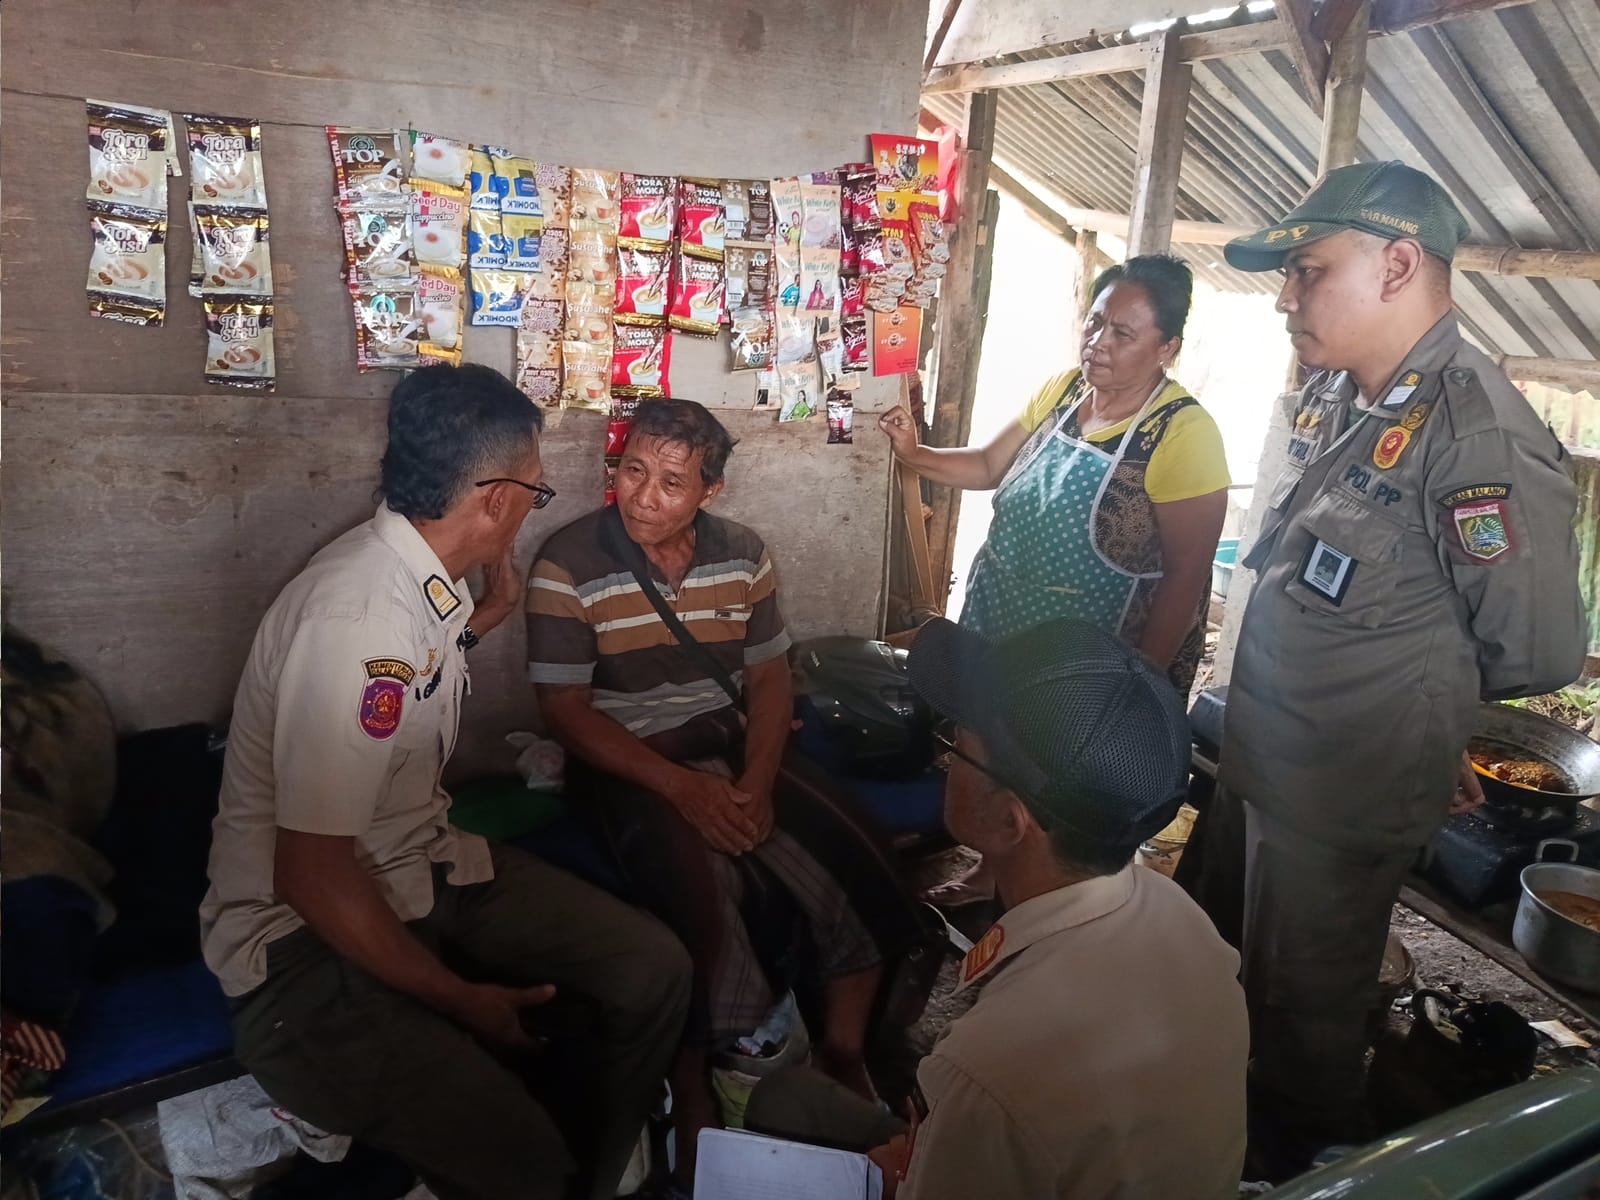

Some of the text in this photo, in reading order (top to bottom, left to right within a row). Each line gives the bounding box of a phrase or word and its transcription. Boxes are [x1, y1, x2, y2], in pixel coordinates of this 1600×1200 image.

[102, 129, 148, 148] Tora
[203, 134, 245, 150] Tora
[341, 149, 384, 163] TOP
[636, 178, 663, 187] TORA
[635, 187, 665, 195] MOKA
[697, 189, 722, 198] TORA
[750, 187, 768, 196] TOP
[411, 193, 461, 214] Good Day
[507, 200, 540, 210] NDOMILK
[509, 260, 540, 269] NDOMILK
[693, 263, 719, 272] TORA
[752, 259, 768, 267] TOP
[691, 271, 720, 280] MOKA
[435, 280, 457, 296] Day
[221, 314, 258, 329] Tora
[479, 314, 519, 323] NDOMILK
[222, 326, 258, 341] Susu
[627, 331, 653, 339] TORA
[627, 338, 655, 347] MOKA
[1344, 463, 1402, 506] POL PP
